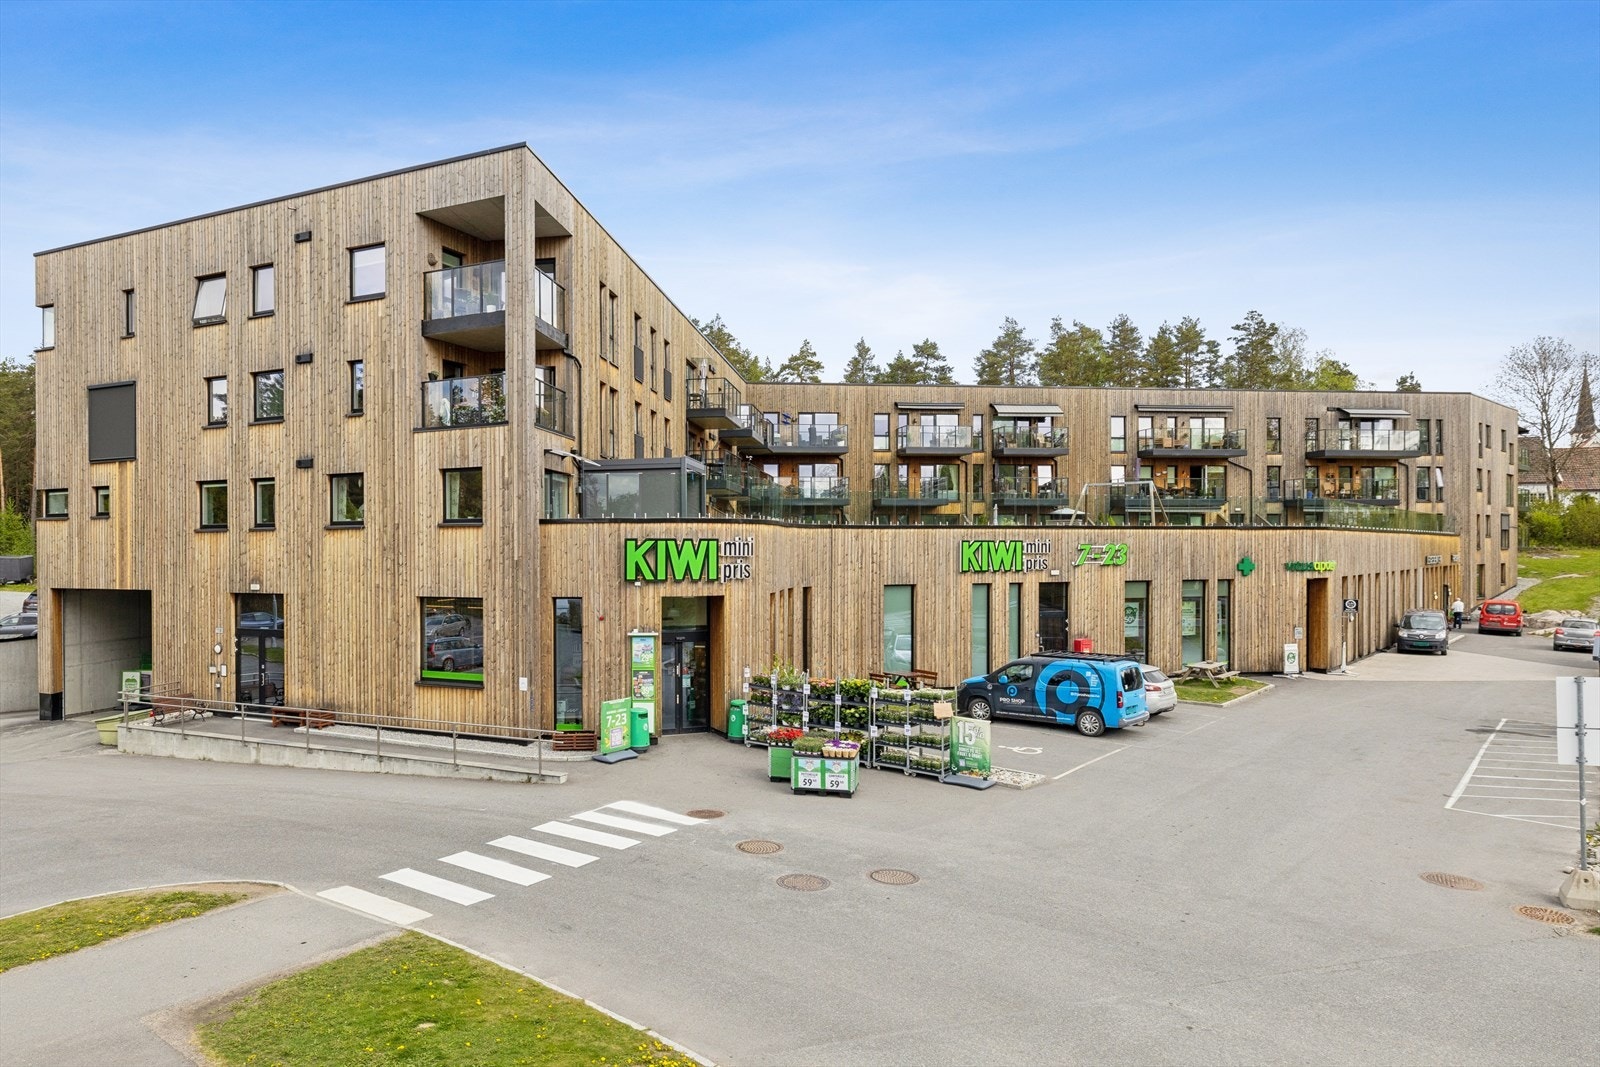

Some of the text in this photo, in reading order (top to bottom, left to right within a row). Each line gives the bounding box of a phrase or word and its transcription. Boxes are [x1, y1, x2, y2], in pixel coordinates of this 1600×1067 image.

[723, 537, 754, 556] mini
[1025, 539, 1051, 554] mini
[625, 538, 719, 582] KIWI
[960, 540, 1024, 573] KIWI
[1025, 554, 1048, 572] pris
[723, 559, 751, 582] pris
[606, 712, 627, 728] 7-23
[802, 778, 813, 787] 59
[829, 780, 840, 788] 59
